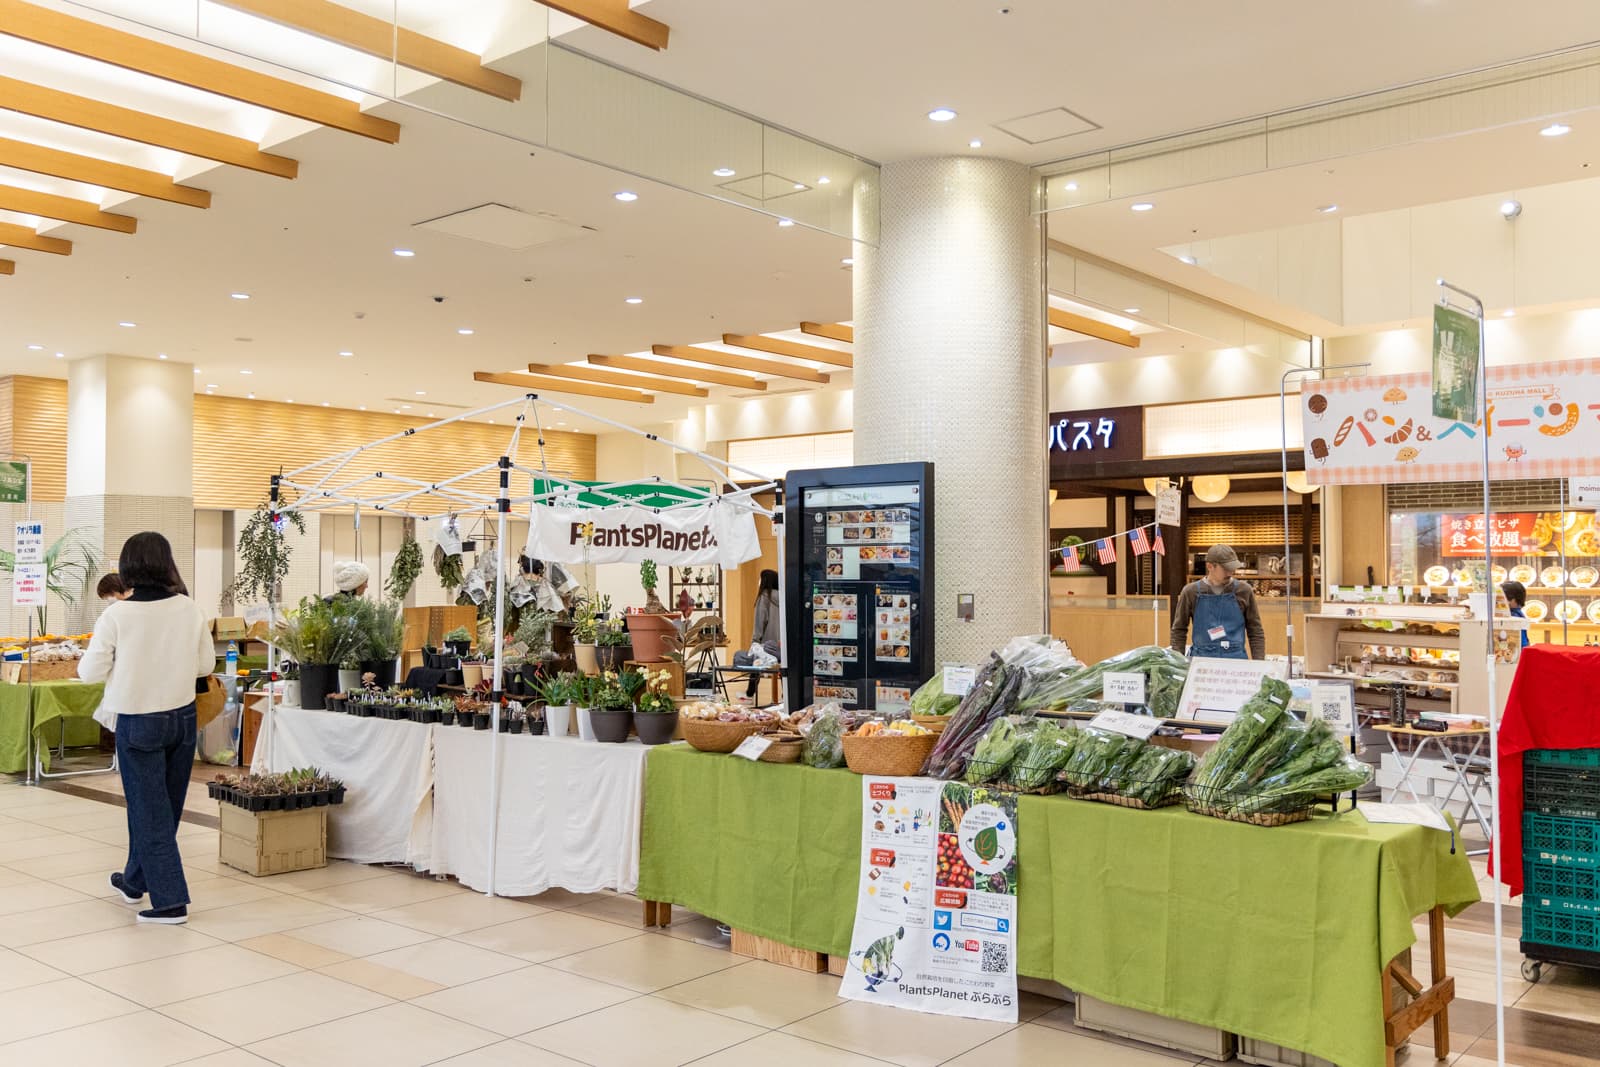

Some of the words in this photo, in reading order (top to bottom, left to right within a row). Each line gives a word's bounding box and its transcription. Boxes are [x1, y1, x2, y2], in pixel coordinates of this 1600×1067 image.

[1049, 417, 1115, 451] パスタ
[954, 939, 980, 952] YouTube
[898, 983, 969, 1001] PlantsPlanet
